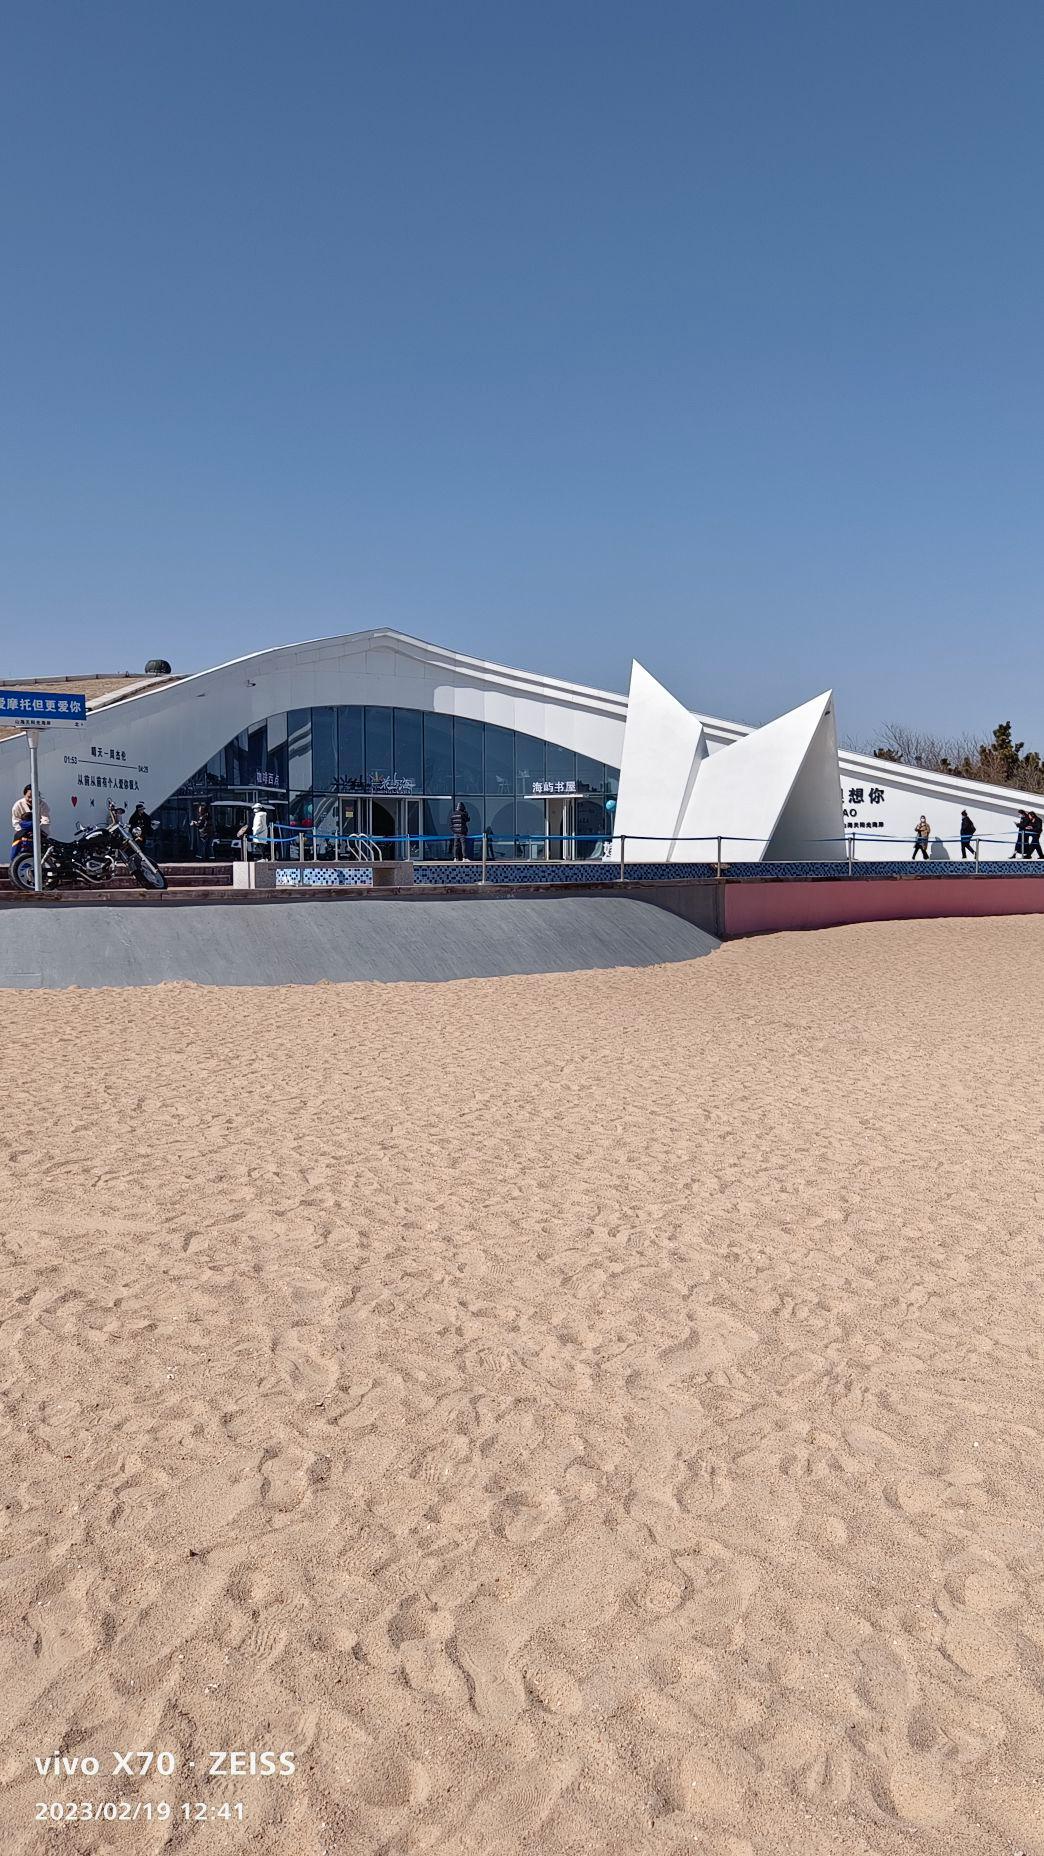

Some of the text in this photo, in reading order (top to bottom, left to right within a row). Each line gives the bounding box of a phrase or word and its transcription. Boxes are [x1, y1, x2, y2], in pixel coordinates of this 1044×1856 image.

[64, 755, 77, 764] 01:53
[77, 774, 139, 791] 从前从前有个人爱你很久
[532, 781, 576, 793] 海屿书屋
[841, 787, 884, 804] 想你
